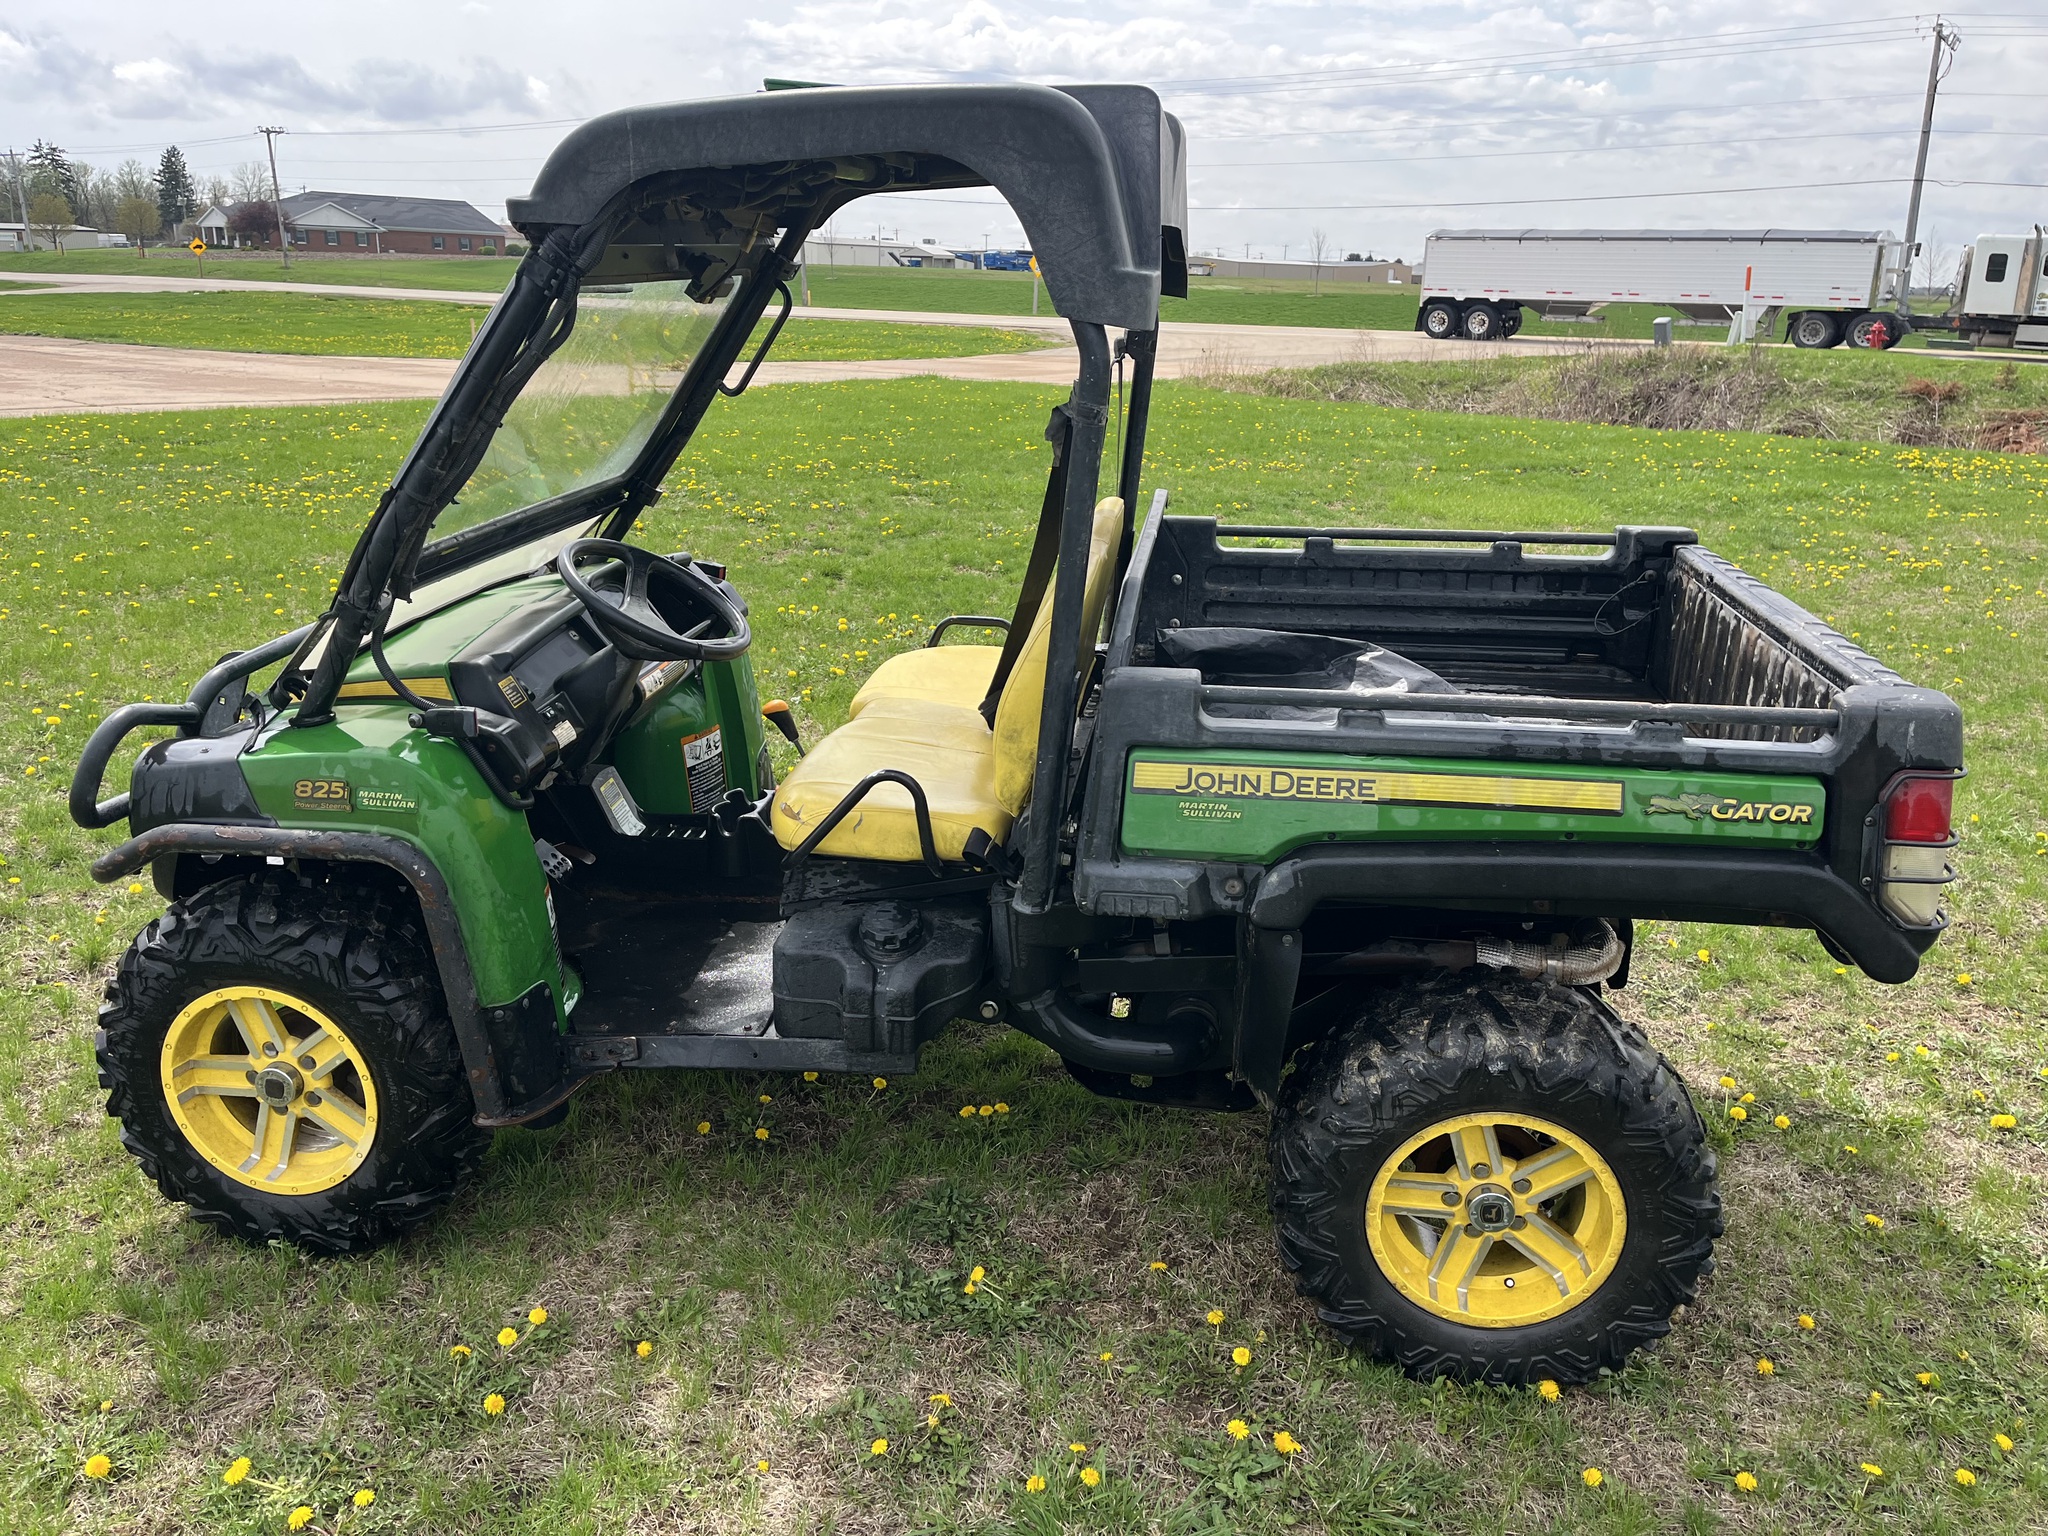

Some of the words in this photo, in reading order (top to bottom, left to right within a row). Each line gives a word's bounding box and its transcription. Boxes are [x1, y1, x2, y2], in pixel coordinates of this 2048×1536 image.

[1175, 767, 1262, 793] JOHN
[1270, 770, 1377, 798] DEERE
[295, 780, 349, 799] 825i
[358, 790, 403, 800] MARTIN
[294, 801, 318, 809] Power
[320, 802, 351, 811] Steering
[362, 798, 416, 809] SULLIVAN
[1178, 801, 1229, 811] MARTIN
[1182, 809, 1242, 820] SULLIVAN
[1711, 798, 1813, 823] GATOR
